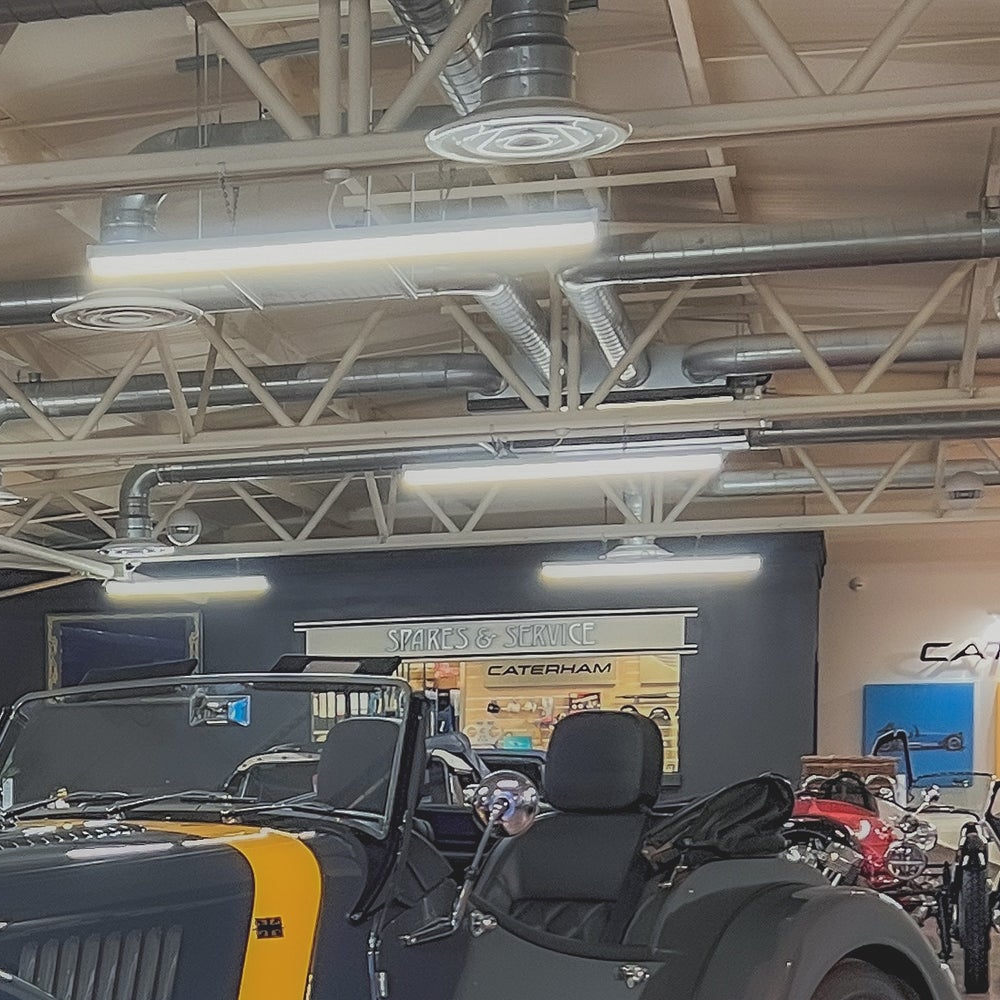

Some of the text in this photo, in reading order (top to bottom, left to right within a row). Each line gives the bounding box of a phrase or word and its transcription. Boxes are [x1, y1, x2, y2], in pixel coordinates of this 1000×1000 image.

[387, 622, 595, 652] SPARES & SERVICE
[487, 663, 611, 677] CATERHAM
